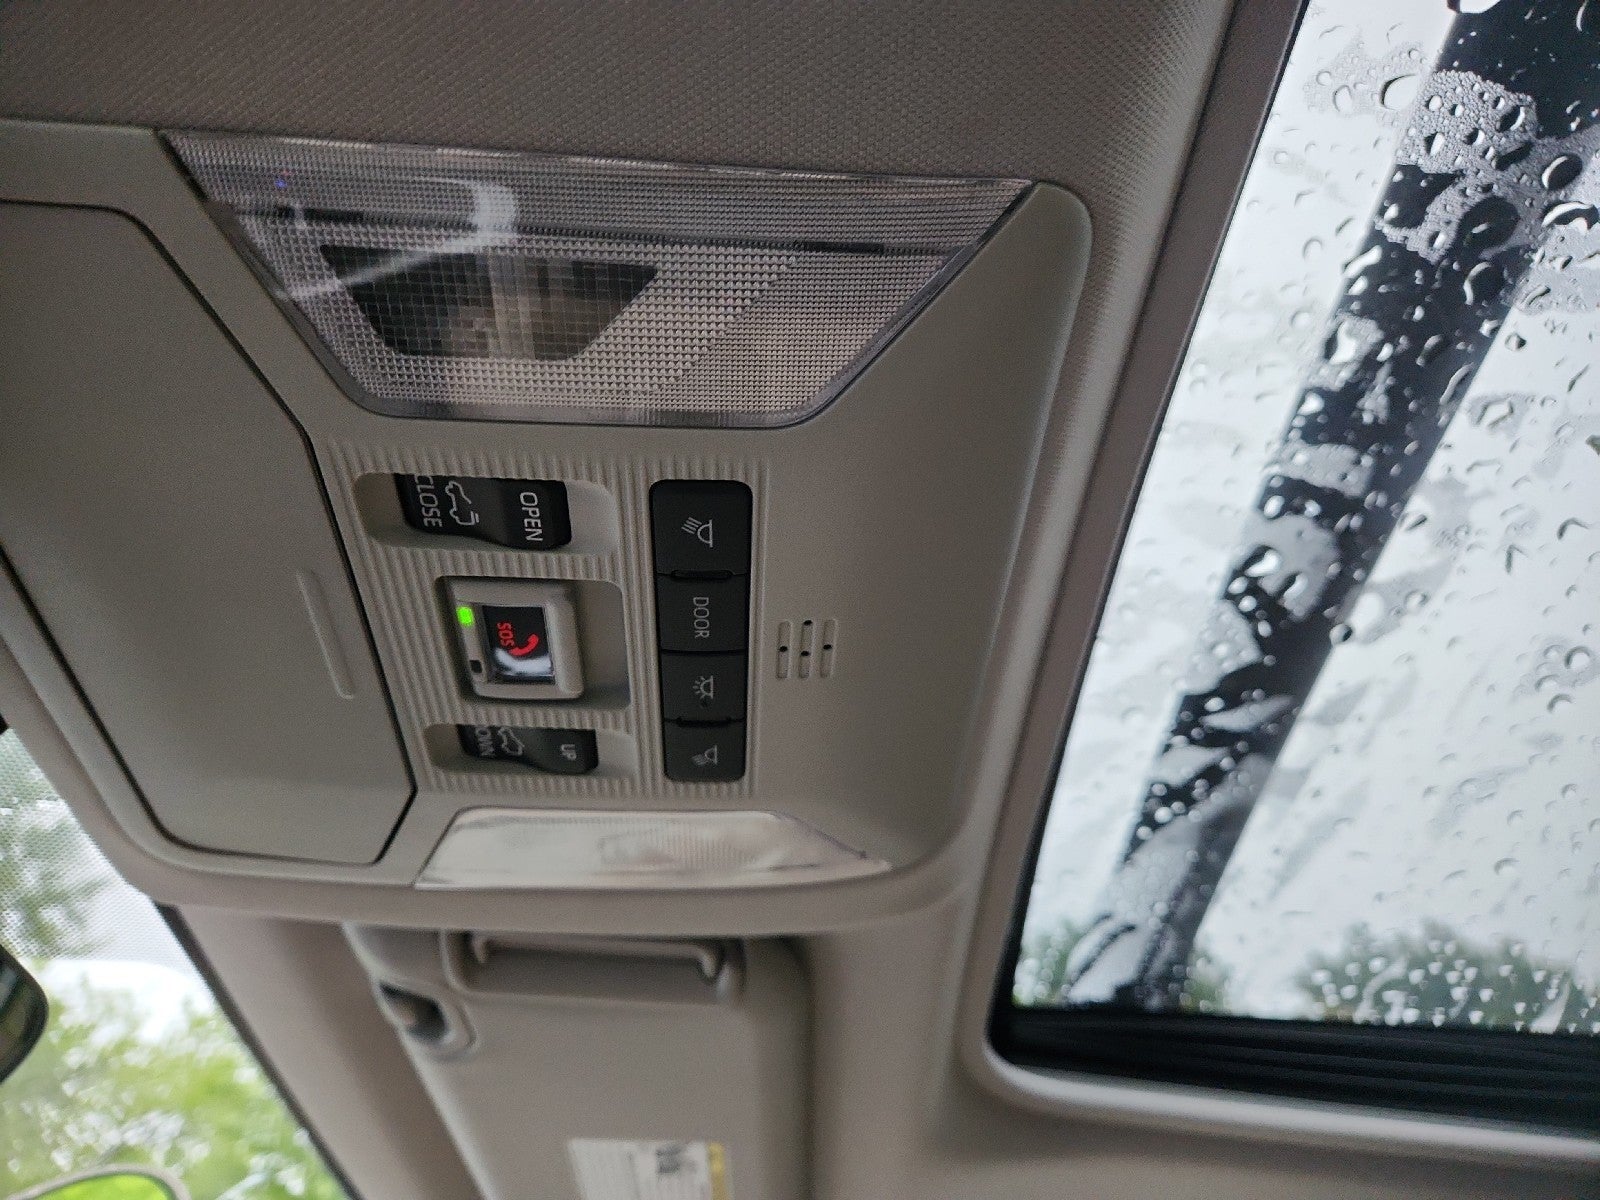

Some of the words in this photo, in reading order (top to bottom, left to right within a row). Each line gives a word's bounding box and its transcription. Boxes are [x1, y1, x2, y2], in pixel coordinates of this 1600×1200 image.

[519, 491, 544, 542] OPEN
[496, 621, 515, 647] SOS
[692, 596, 709, 639] DOOR
[560, 743, 577, 760] UP
